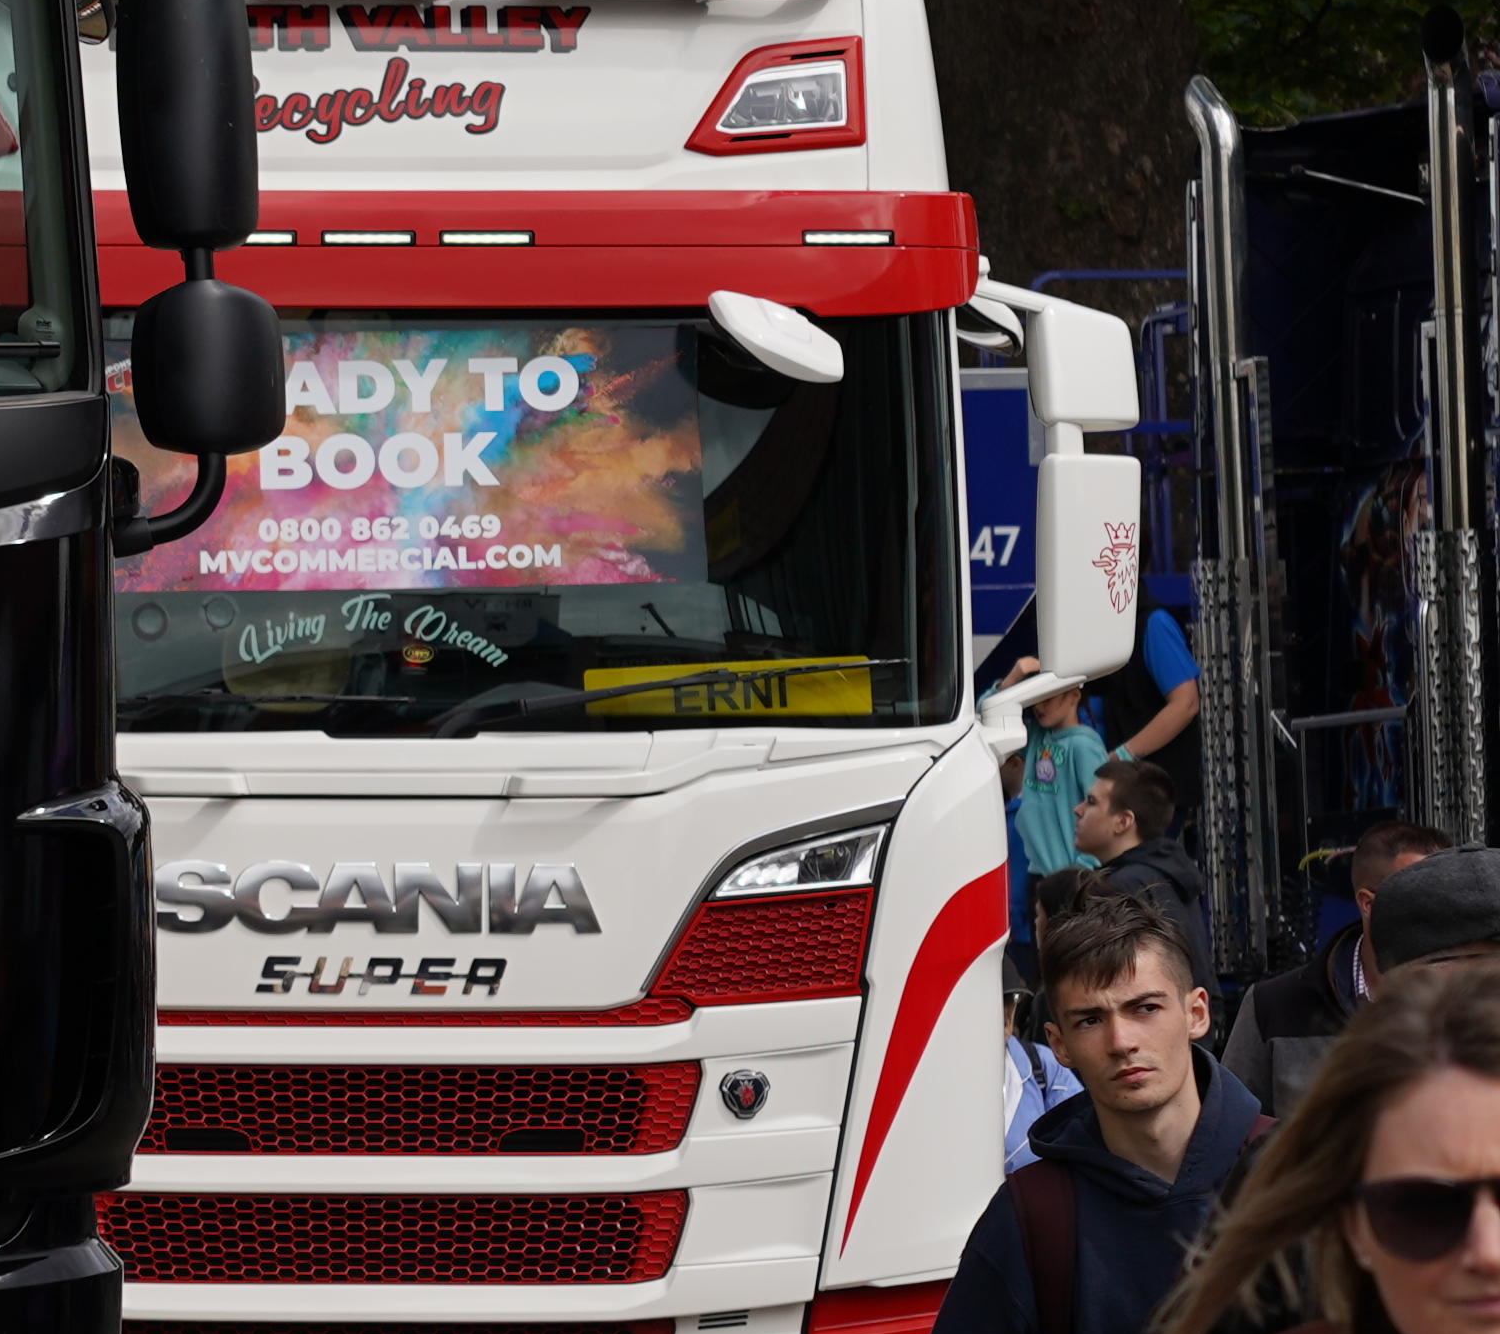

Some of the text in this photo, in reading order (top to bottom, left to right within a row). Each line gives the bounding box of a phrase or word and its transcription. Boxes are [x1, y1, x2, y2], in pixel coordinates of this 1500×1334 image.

[337, 3, 592, 52] VALLEY
[252, 57, 506, 144] ecycling
[468, 355, 580, 413] TO
[259, 431, 501, 491] BOOK
[258, 514, 502, 543] 0800 862 0469
[970, 525, 1021, 567] 47
[199, 543, 563, 575] MVCOMMERCIAL.COM
[238, 593, 509, 667] Living The Dream
[155, 859, 603, 935] SCANIA
[255, 956, 508, 996] SUPER
